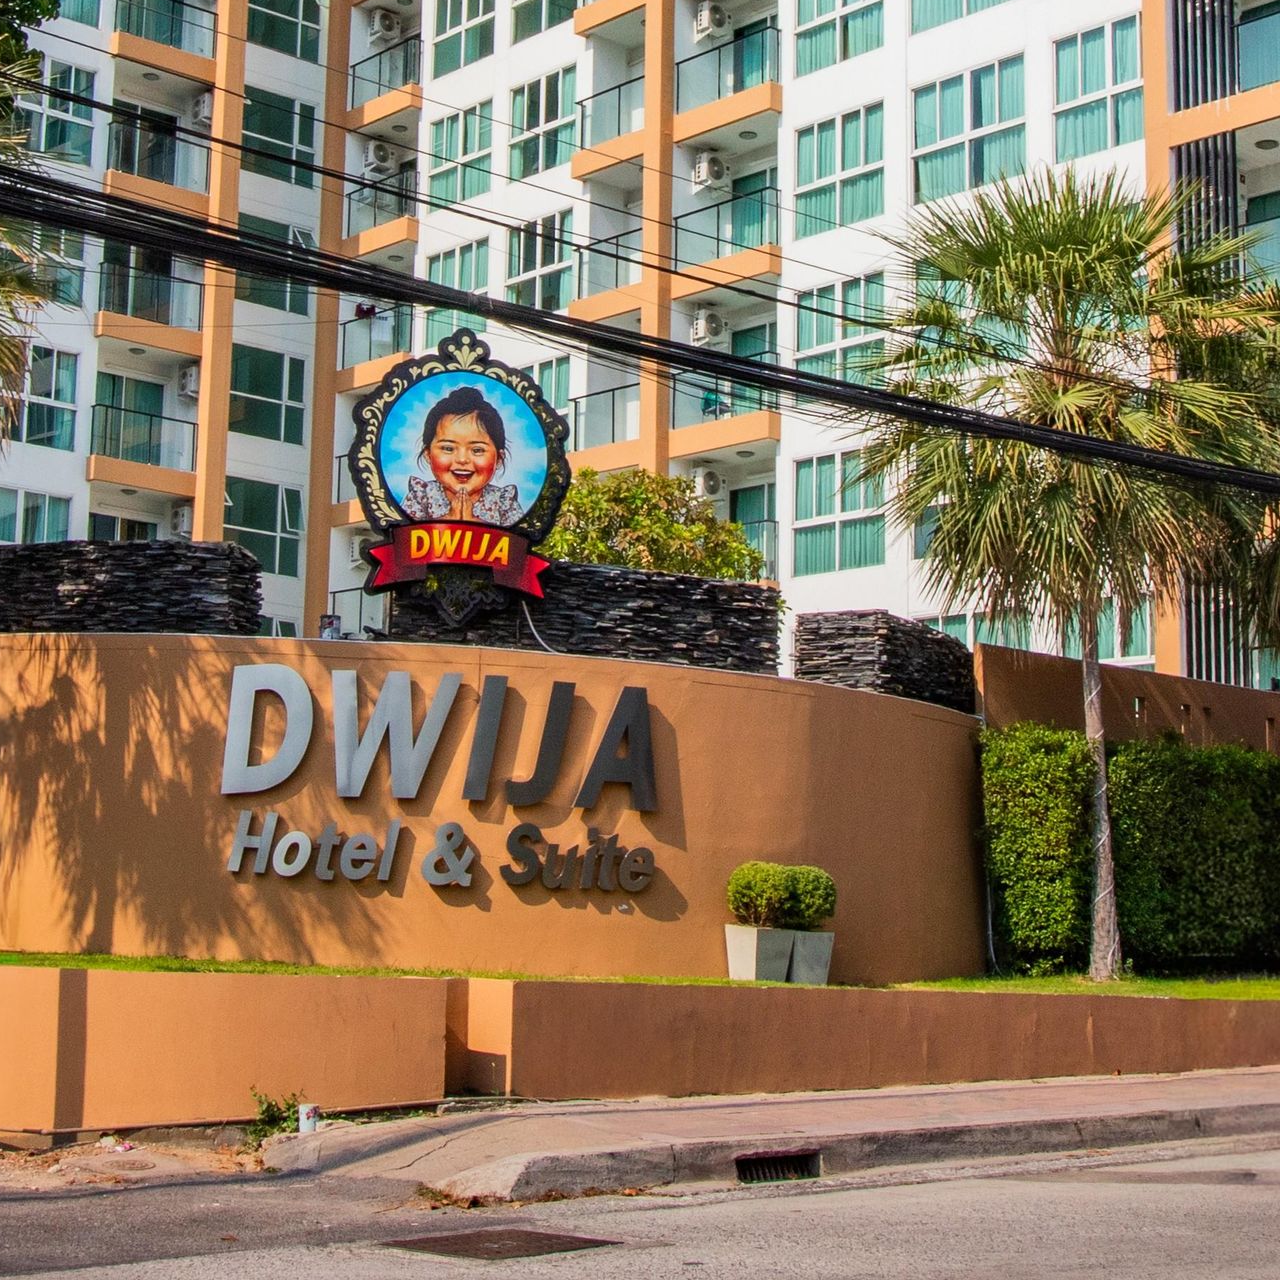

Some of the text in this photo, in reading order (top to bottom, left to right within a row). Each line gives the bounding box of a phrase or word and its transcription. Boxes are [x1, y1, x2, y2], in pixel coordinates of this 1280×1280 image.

[410, 528, 510, 566] DWIJA
[221, 663, 658, 812] DWIJA
[227, 809, 656, 894] Hotel & Suite
